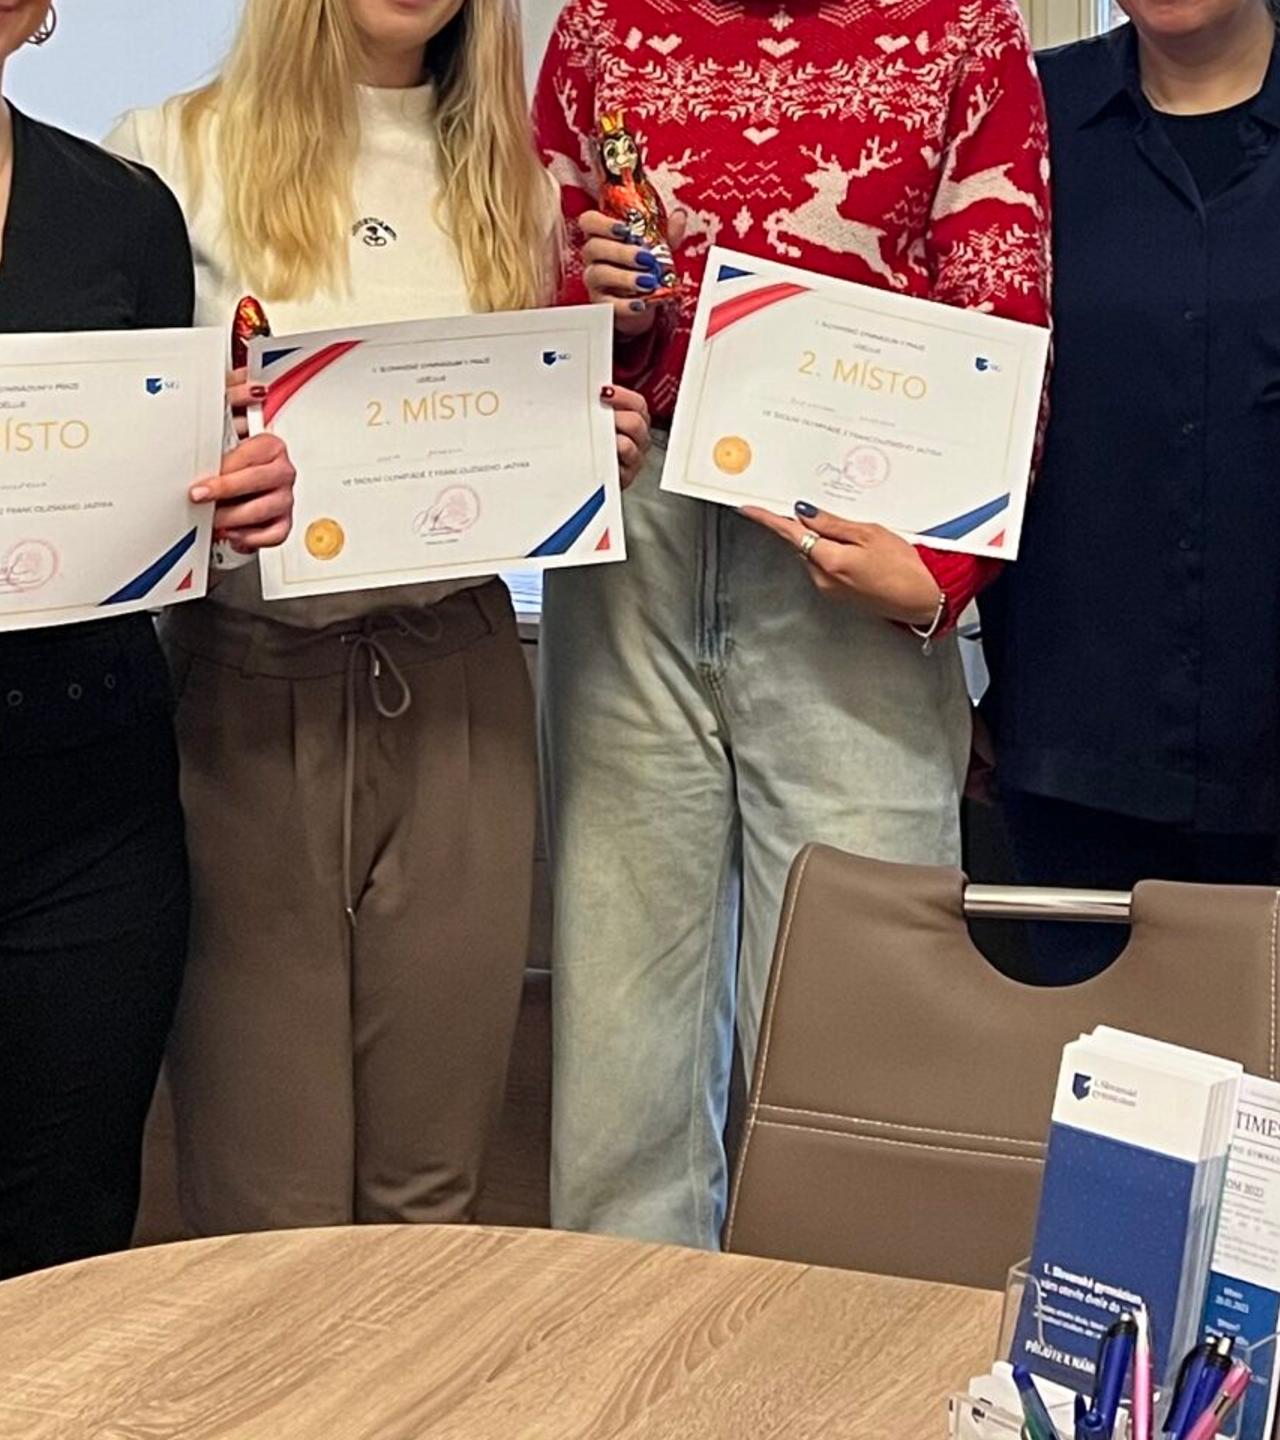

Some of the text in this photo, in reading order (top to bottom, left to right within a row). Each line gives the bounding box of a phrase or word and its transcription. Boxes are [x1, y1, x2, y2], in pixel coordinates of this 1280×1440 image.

[798, 350, 927, 400] 2. MÍSTO
[367, 390, 499, 427] 2. MÍSTO
